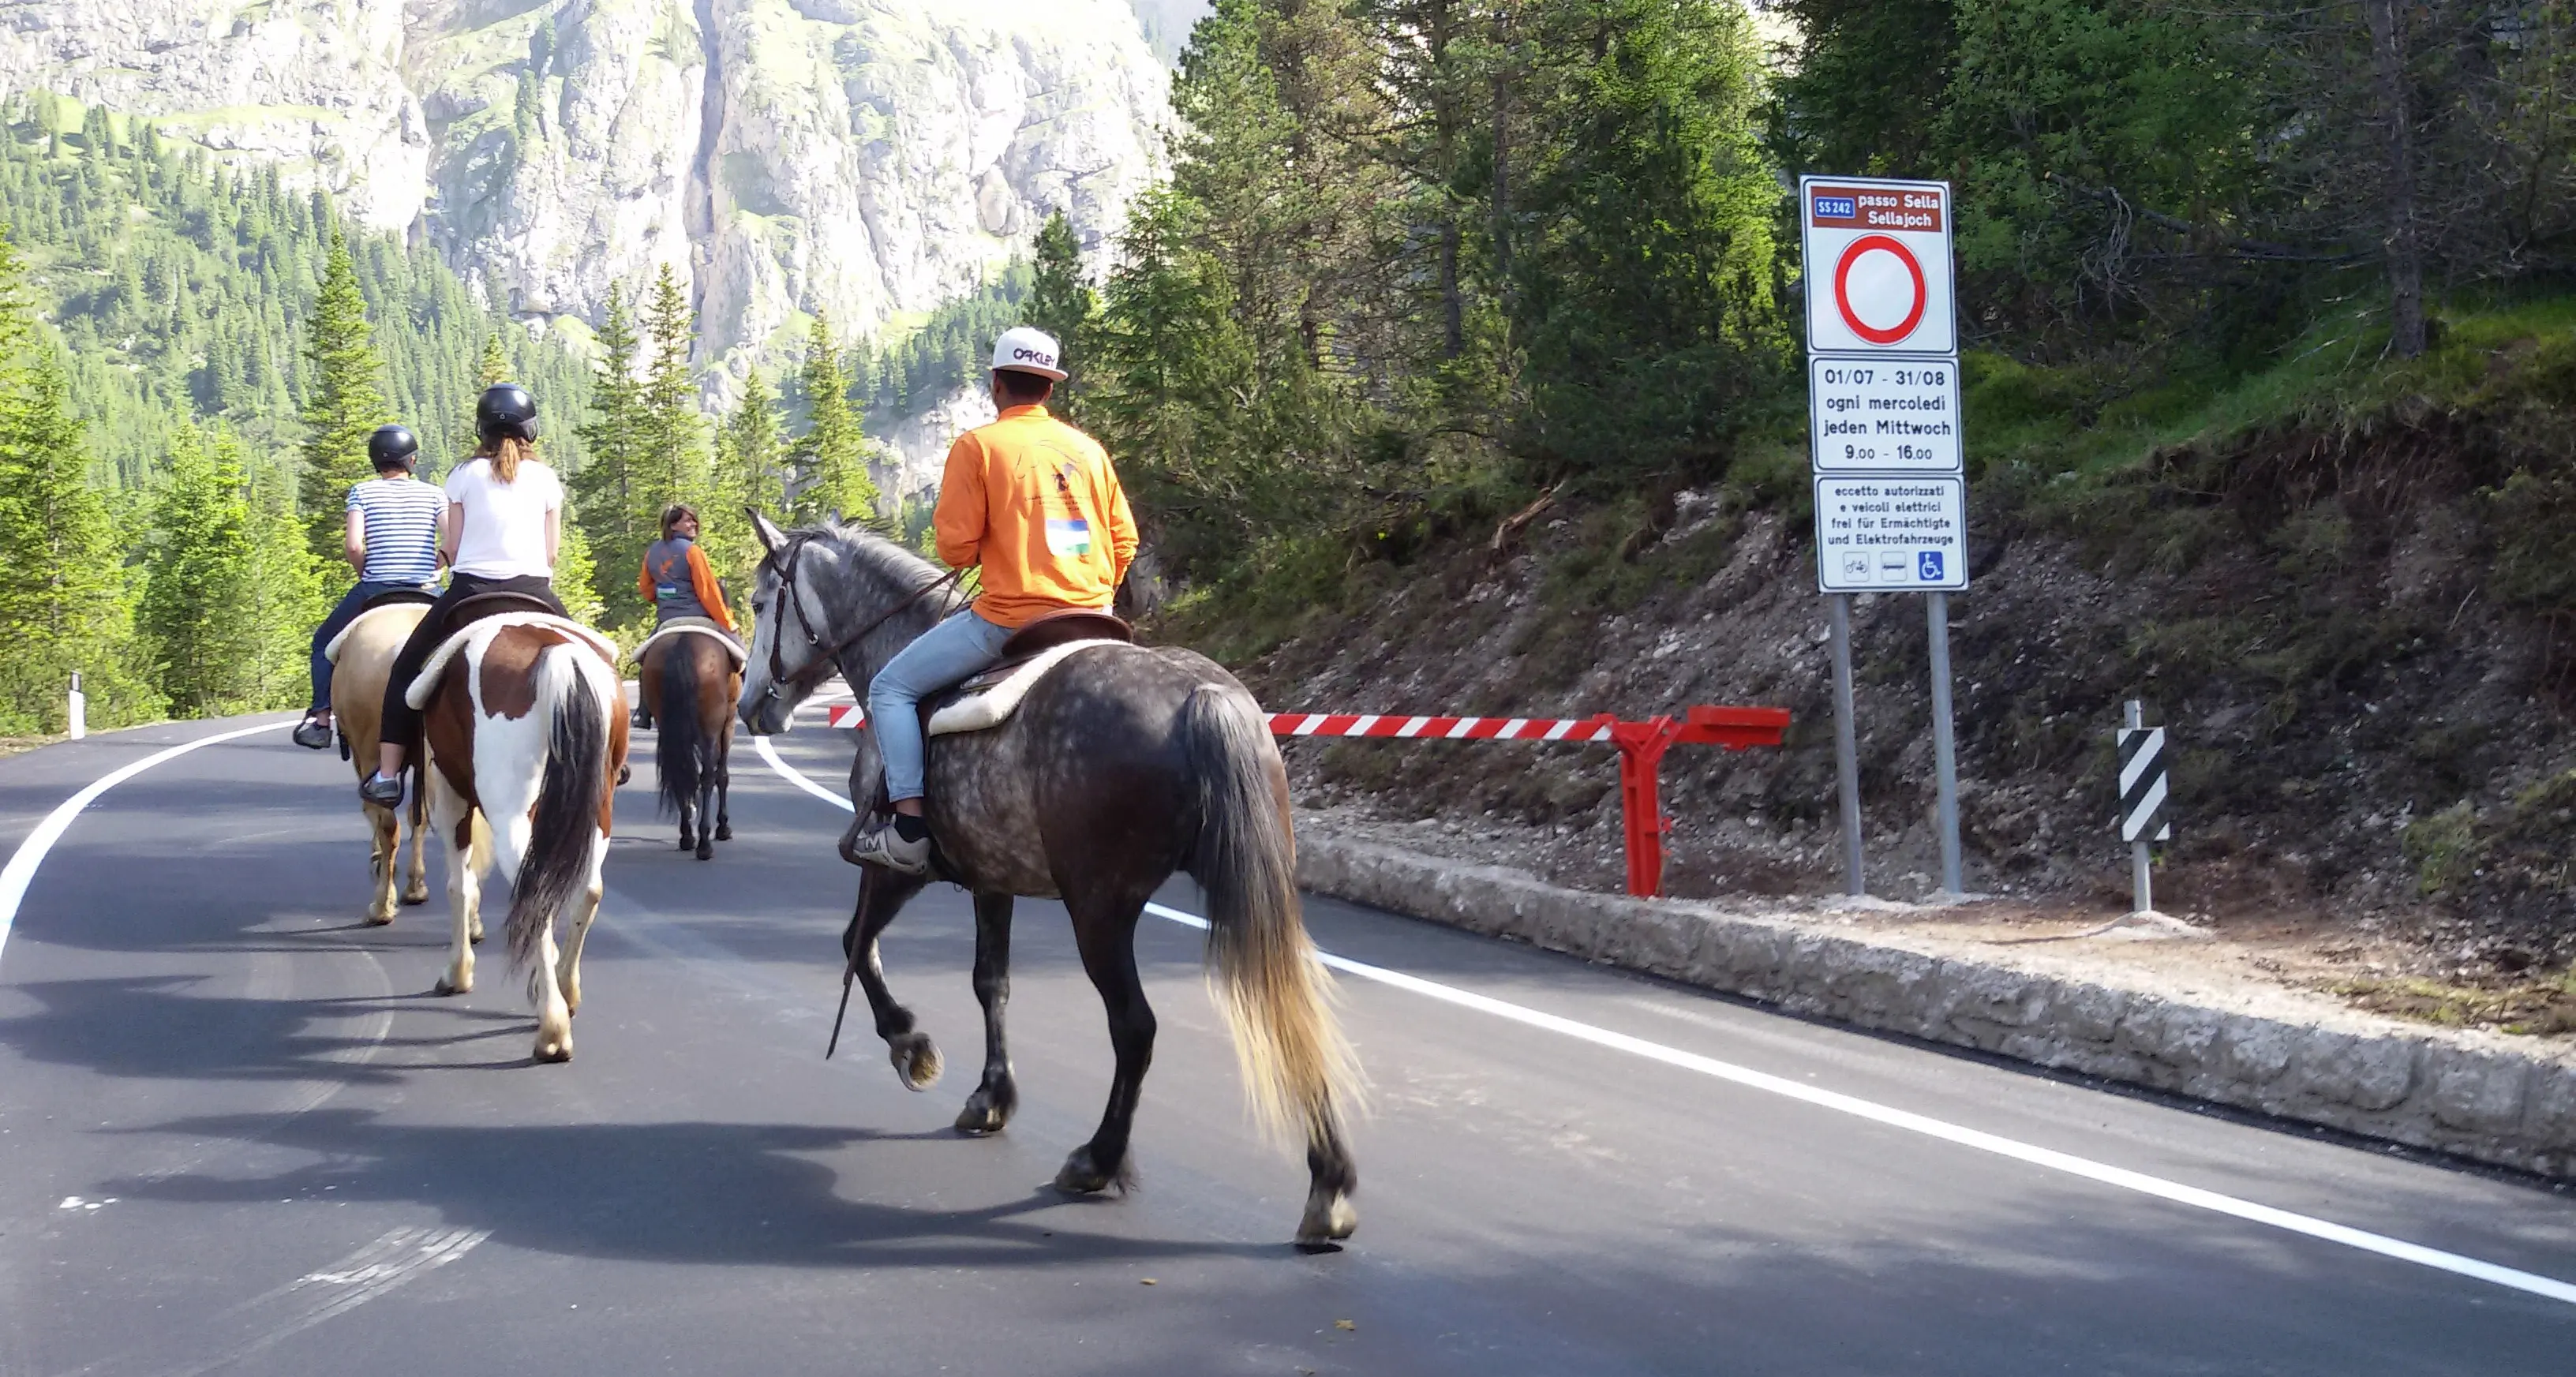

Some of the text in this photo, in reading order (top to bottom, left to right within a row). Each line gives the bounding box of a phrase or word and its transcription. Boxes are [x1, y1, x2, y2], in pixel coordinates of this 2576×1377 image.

[1818, 201, 1851, 214] SS 242
[1858, 194, 1938, 209] passo Sella
[1868, 211, 1932, 228] Sellajoch
[1825, 369, 1874, 385] 01/07
[1896, 370, 1945, 386] 31/08
[1826, 395, 1860, 412] ogni
[1824, 419, 1951, 436] jeden Mittwoch
[1845, 444, 1875, 459] 9.00
[1897, 445, 1933, 459] 16.00
[1834, 485, 1945, 496] eccetto autorizzati
[1852, 502, 1889, 512] veicoli
[1895, 502, 1941, 512] elettrici
[1831, 518, 1951, 530] frei für Ermächtigte
[1828, 533, 1954, 546] und Elektrofahrzeuge
